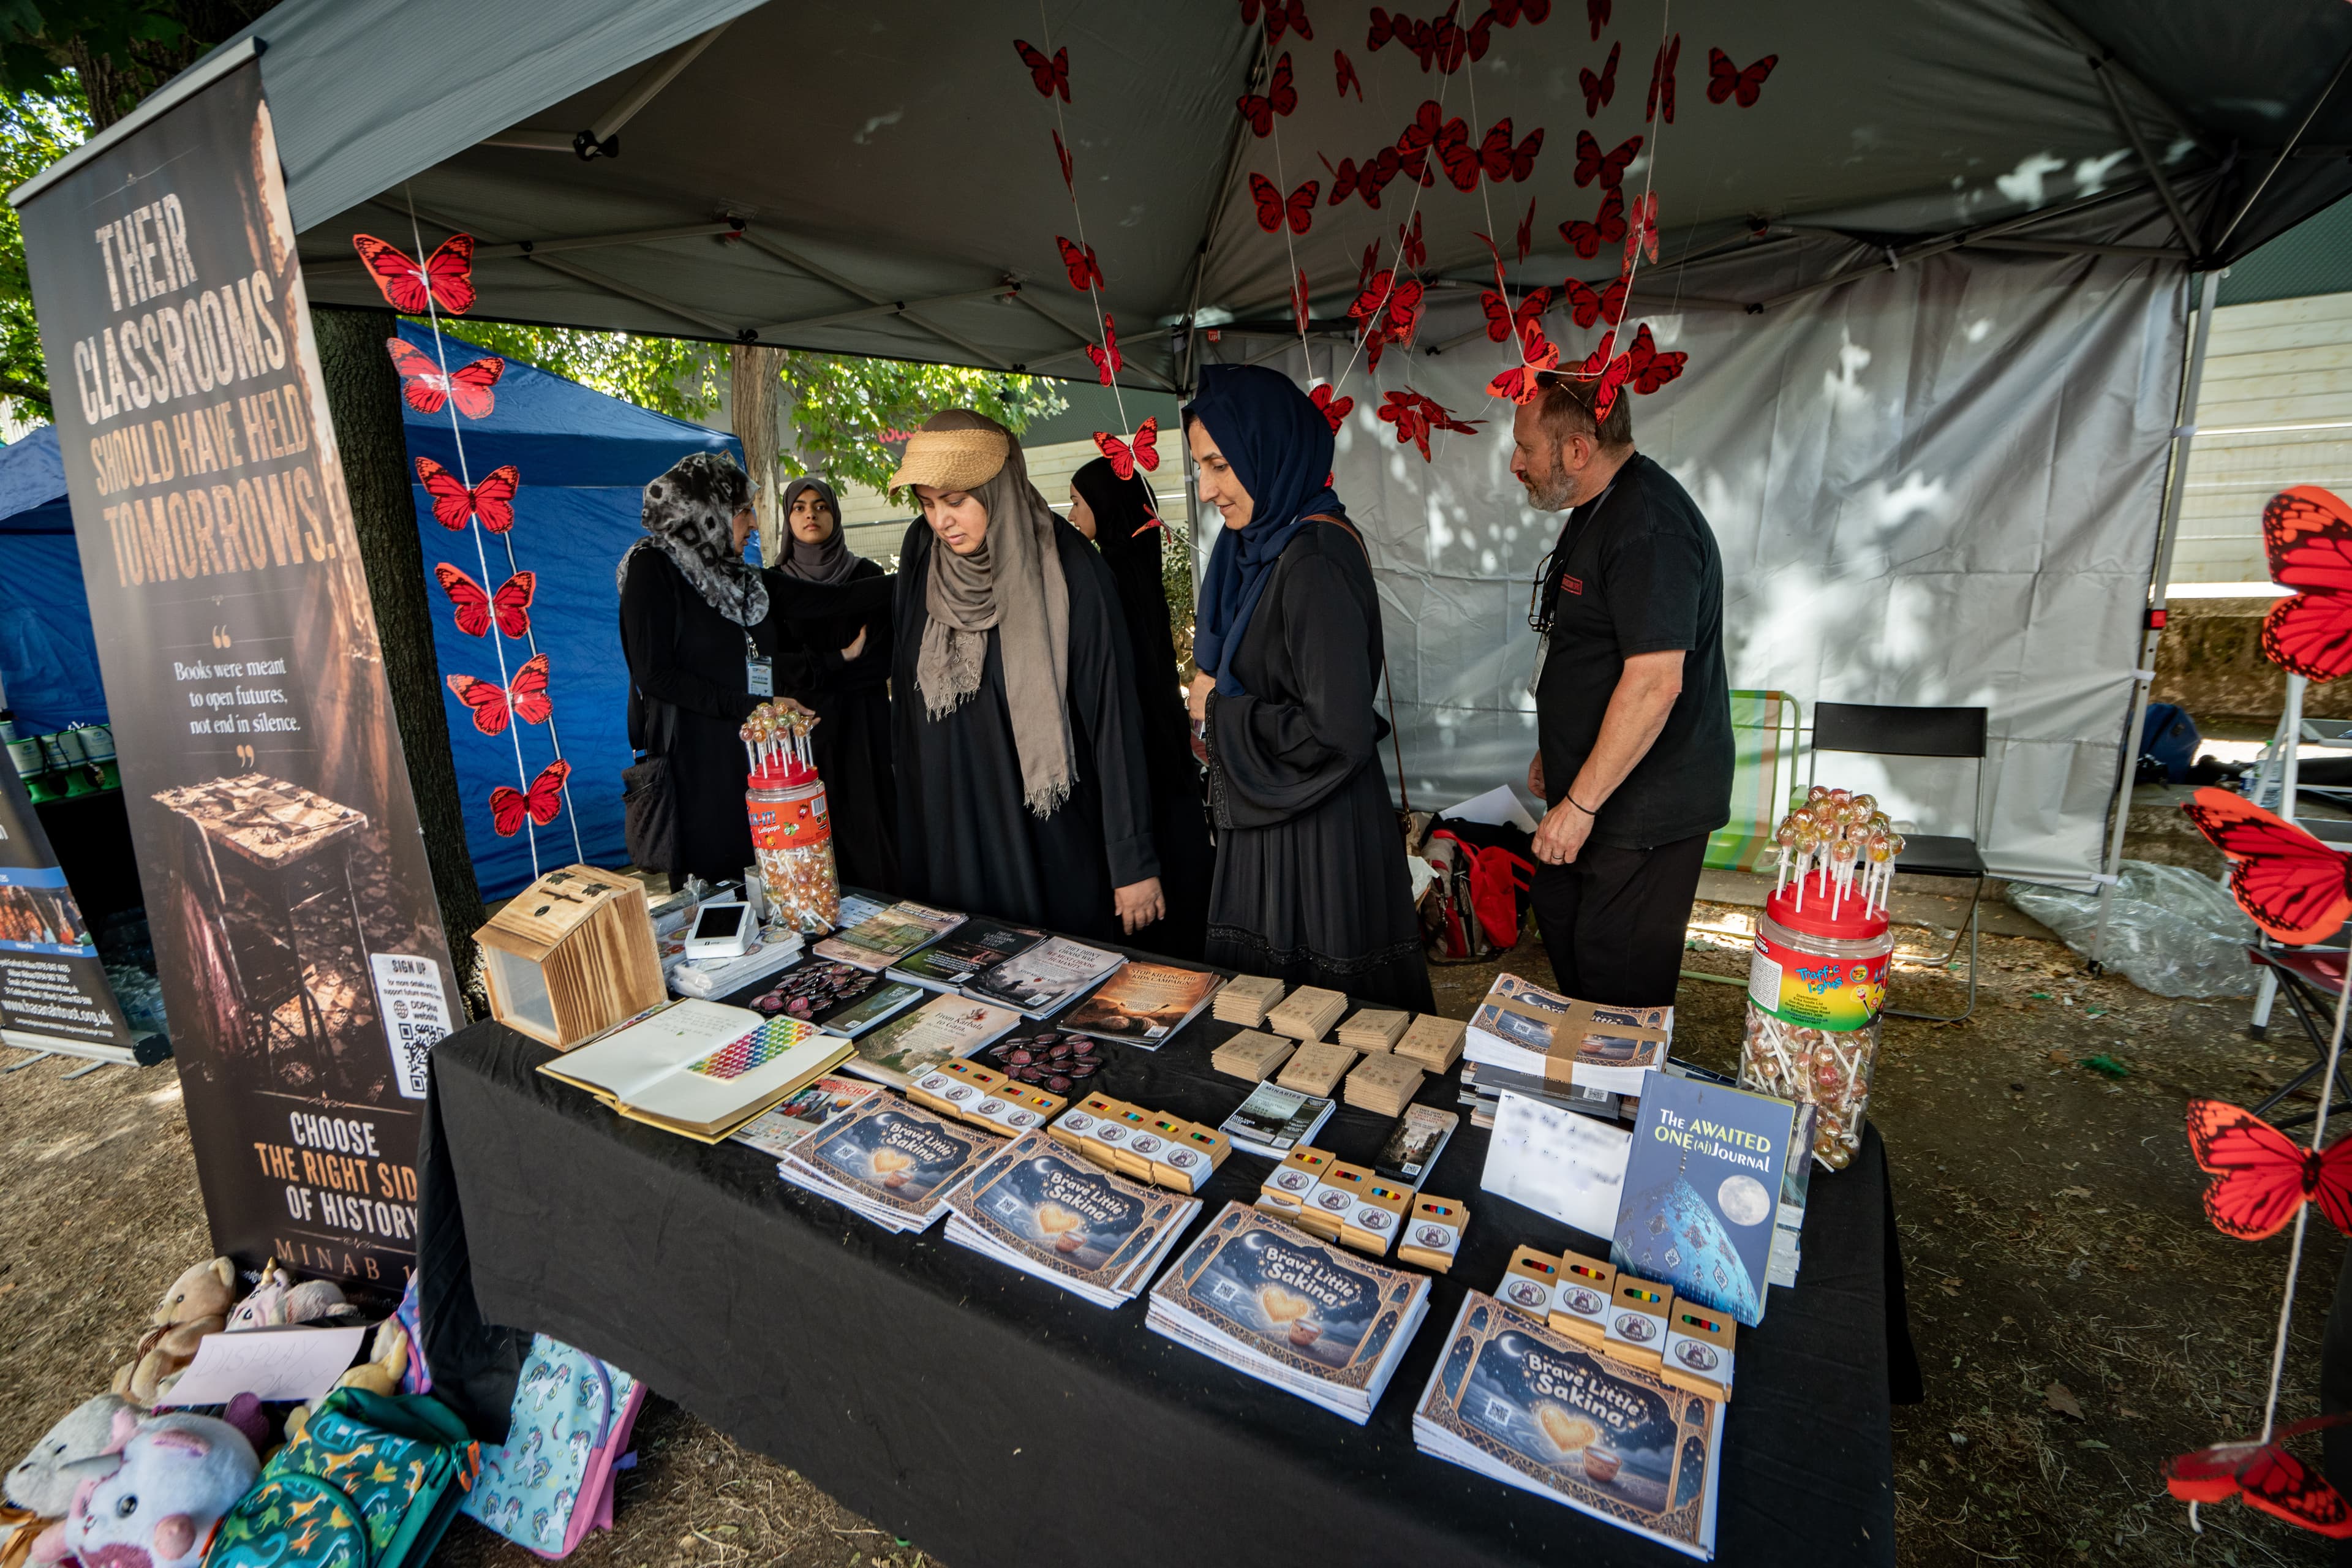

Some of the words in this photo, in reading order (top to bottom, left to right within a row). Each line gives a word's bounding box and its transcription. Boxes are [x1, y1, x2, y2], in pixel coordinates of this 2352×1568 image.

[96, 194, 198, 311] THEIR
[74, 270, 287, 425] CLASSROOMS
[91, 420, 174, 496] SHOULD
[178, 401, 243, 475] HAVE
[245, 383, 307, 462] HELD
[104, 467, 336, 587] TOMORROWS.
[174, 660, 213, 681] Books
[214, 660, 243, 678] were
[246, 657, 287, 676] meant
[189, 690, 205, 707] to
[206, 690, 234, 710] open
[235, 686, 288, 706] futures,
[190, 717, 213, 734] not
[214, 717, 235, 733] end
[236, 715, 251, 732] in
[252, 714, 301, 732] silence.
[758, 824, 781, 835] Lollipops
[392, 960, 415, 973] SIGN
[416, 962, 426, 975] UP
[1132, 969, 1152, 978] STOP
[1152, 971, 1182, 980] KILLING
[1151, 977, 1191, 986] CAMPAIGN
[1795, 965, 1841, 982] Traffic
[1807, 977, 1844, 995] lights
[935, 1012, 955, 1022] From
[954, 1017, 984, 1030] Karbala
[1795, 1004, 1819, 1014] Cambridge
[290, 1111, 380, 1158] CHOOSE
[887, 1132, 938, 1163] Sakina
[889, 1122, 923, 1143] Brave
[924, 1134, 953, 1157] Little
[1654, 1126, 1694, 1150] ONE
[1689, 1118, 1771, 1153] AWAITED
[254, 1142, 300, 1182] THE
[301, 1149, 371, 1194] RIGHT
[285, 1185, 313, 1221] OF
[1048, 1185, 1109, 1222] Sakina
[1049, 1171, 1090, 1197] Brave
[1090, 1189, 1123, 1216] Little
[274, 1237, 380, 1280] MINAB
[1265, 1245, 1313, 1274] Brave
[1313, 1267, 1355, 1298] Little
[1267, 1262, 1339, 1306] Sakina
[196, 1339, 319, 1377] DISPLAY
[1529, 1353, 1585, 1389] Brave
[1588, 1379, 1640, 1417] Little
[1536, 1373, 1625, 1428] Sakina
